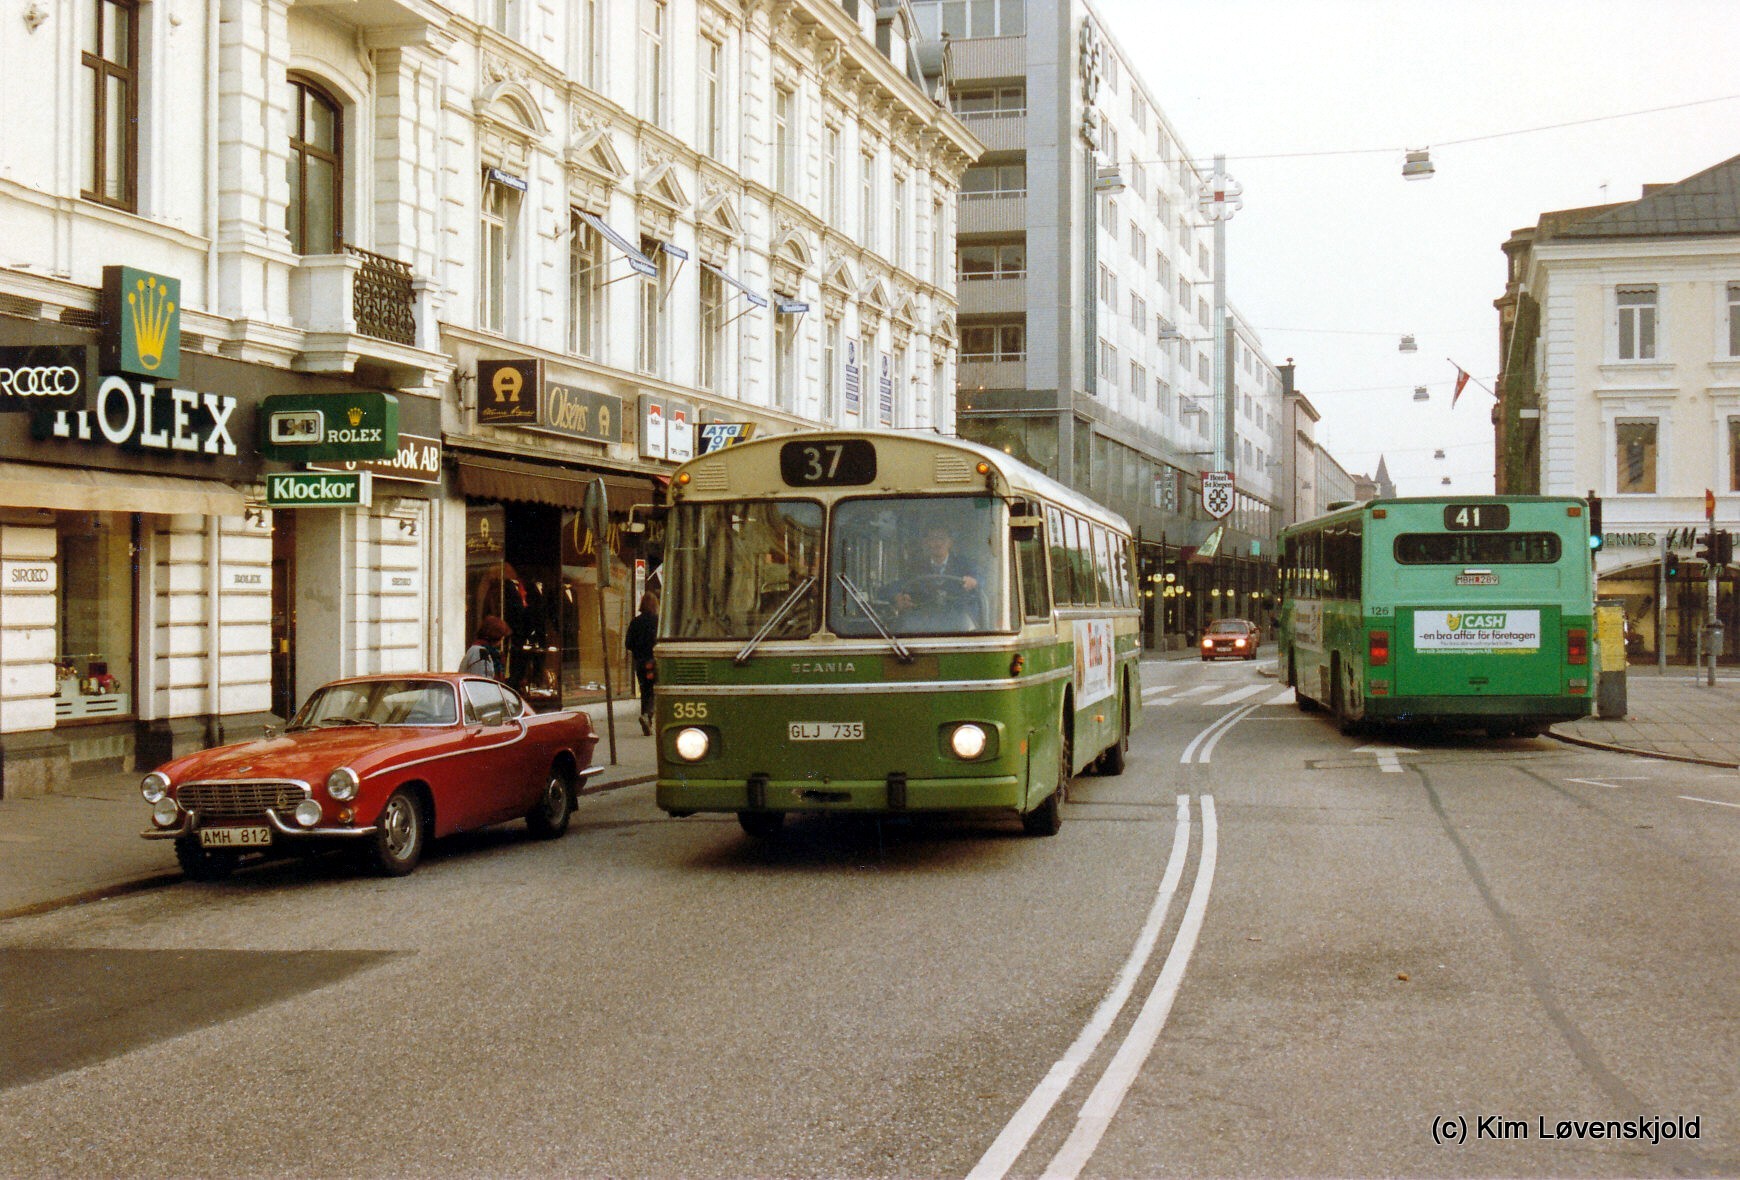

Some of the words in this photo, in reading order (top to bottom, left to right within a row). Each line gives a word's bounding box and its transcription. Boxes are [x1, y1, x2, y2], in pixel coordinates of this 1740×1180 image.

[327, 428, 382, 443] ROLEX
[705, 425, 737, 436] ATG
[420, 445, 439, 473] AB
[802, 445, 843, 480] 37
[273, 477, 355, 499] Klockor
[1455, 507, 1480, 527] 41
[234, 574, 262, 584] ROLEX
[1371, 607, 1389, 616] 126
[1464, 616, 1504, 628] CASH
[1436, 630, 1456, 640] bra
[1457, 630, 1475, 640] affär
[1478, 630, 1490, 640] för
[1492, 630, 1536, 642] företagen
[791, 662, 856, 674] SCANIA
[673, 702, 708, 719] 355
[791, 724, 821, 738] GLJ
[832, 724, 862, 738] 735
[203, 830, 232, 844] AMH
[241, 829, 269, 843] 812
